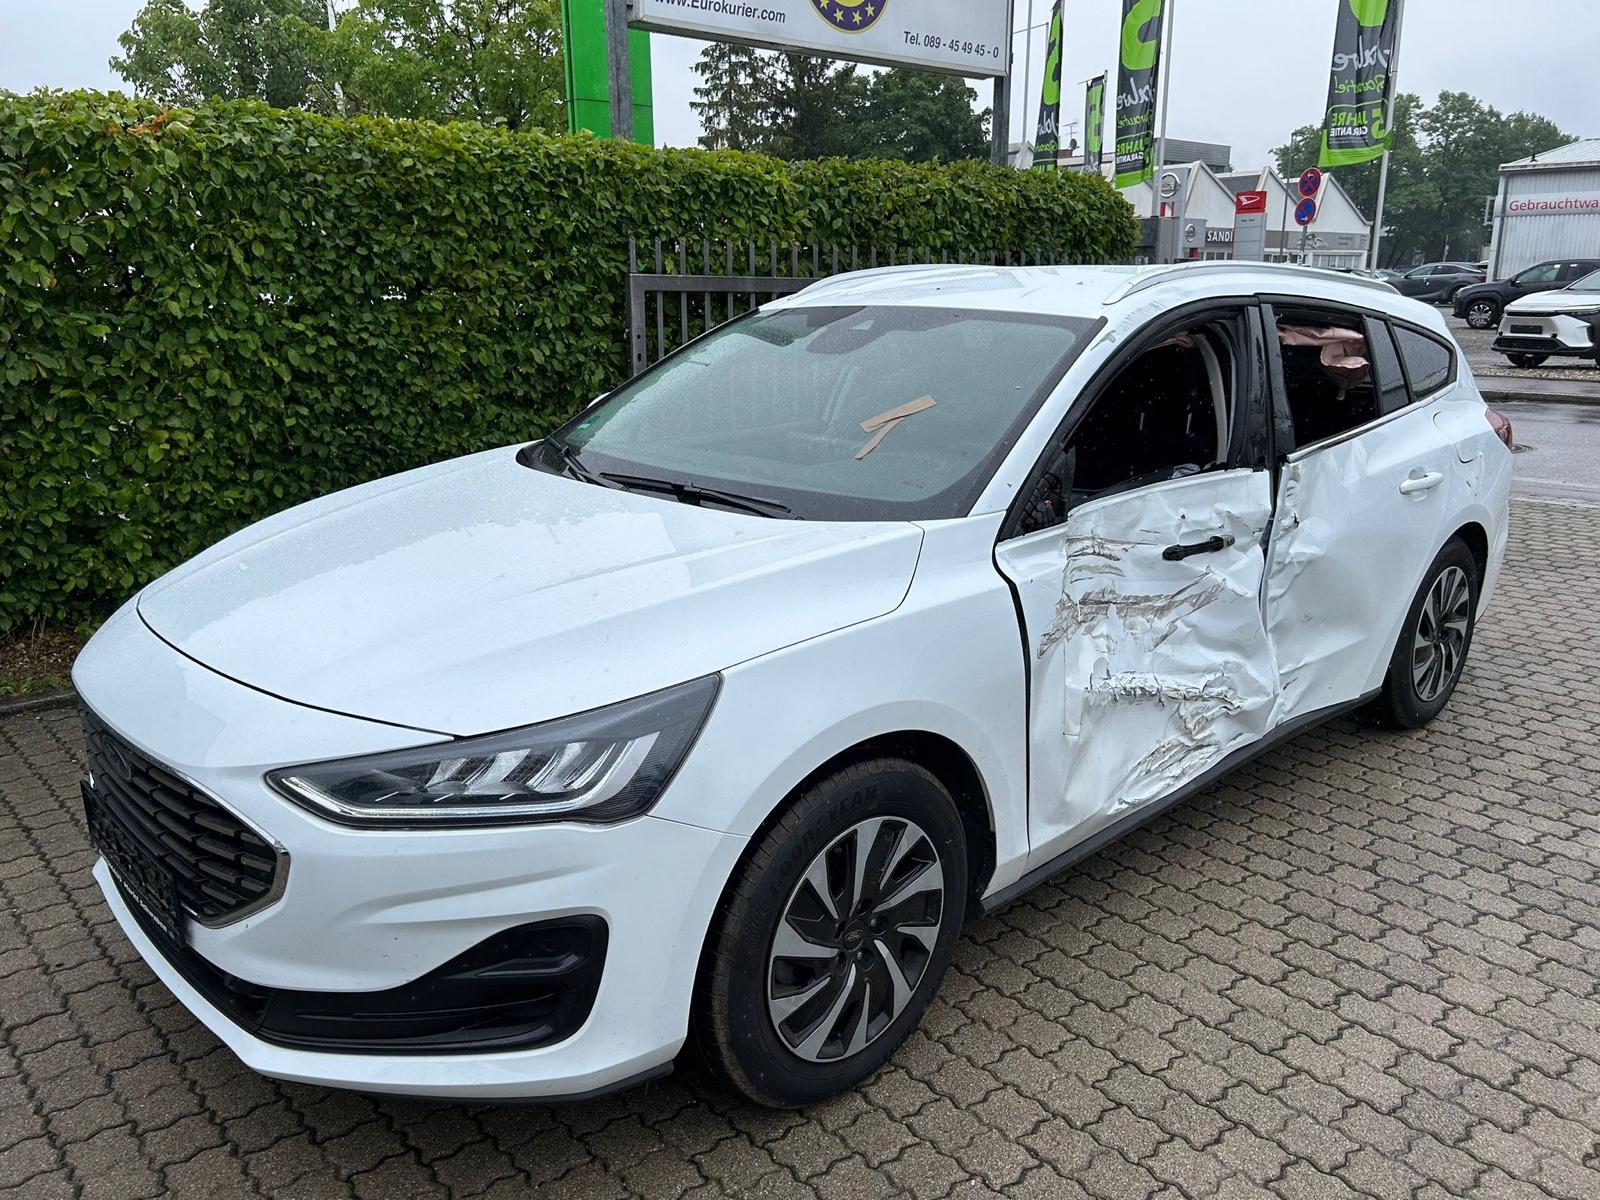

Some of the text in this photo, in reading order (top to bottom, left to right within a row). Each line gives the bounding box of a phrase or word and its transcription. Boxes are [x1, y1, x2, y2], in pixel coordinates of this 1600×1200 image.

[656, 0, 786, 23] w.Eurokurier.com
[904, 31, 921, 46] Tel.
[924, 35, 941, 49] 089
[949, 39, 960, 52] 45
[961, 41, 973, 54] 49
[974, 43, 986, 56] 45
[993, 46, 999, 58] 0
[1509, 198, 1600, 212] Gebrauchtwa
